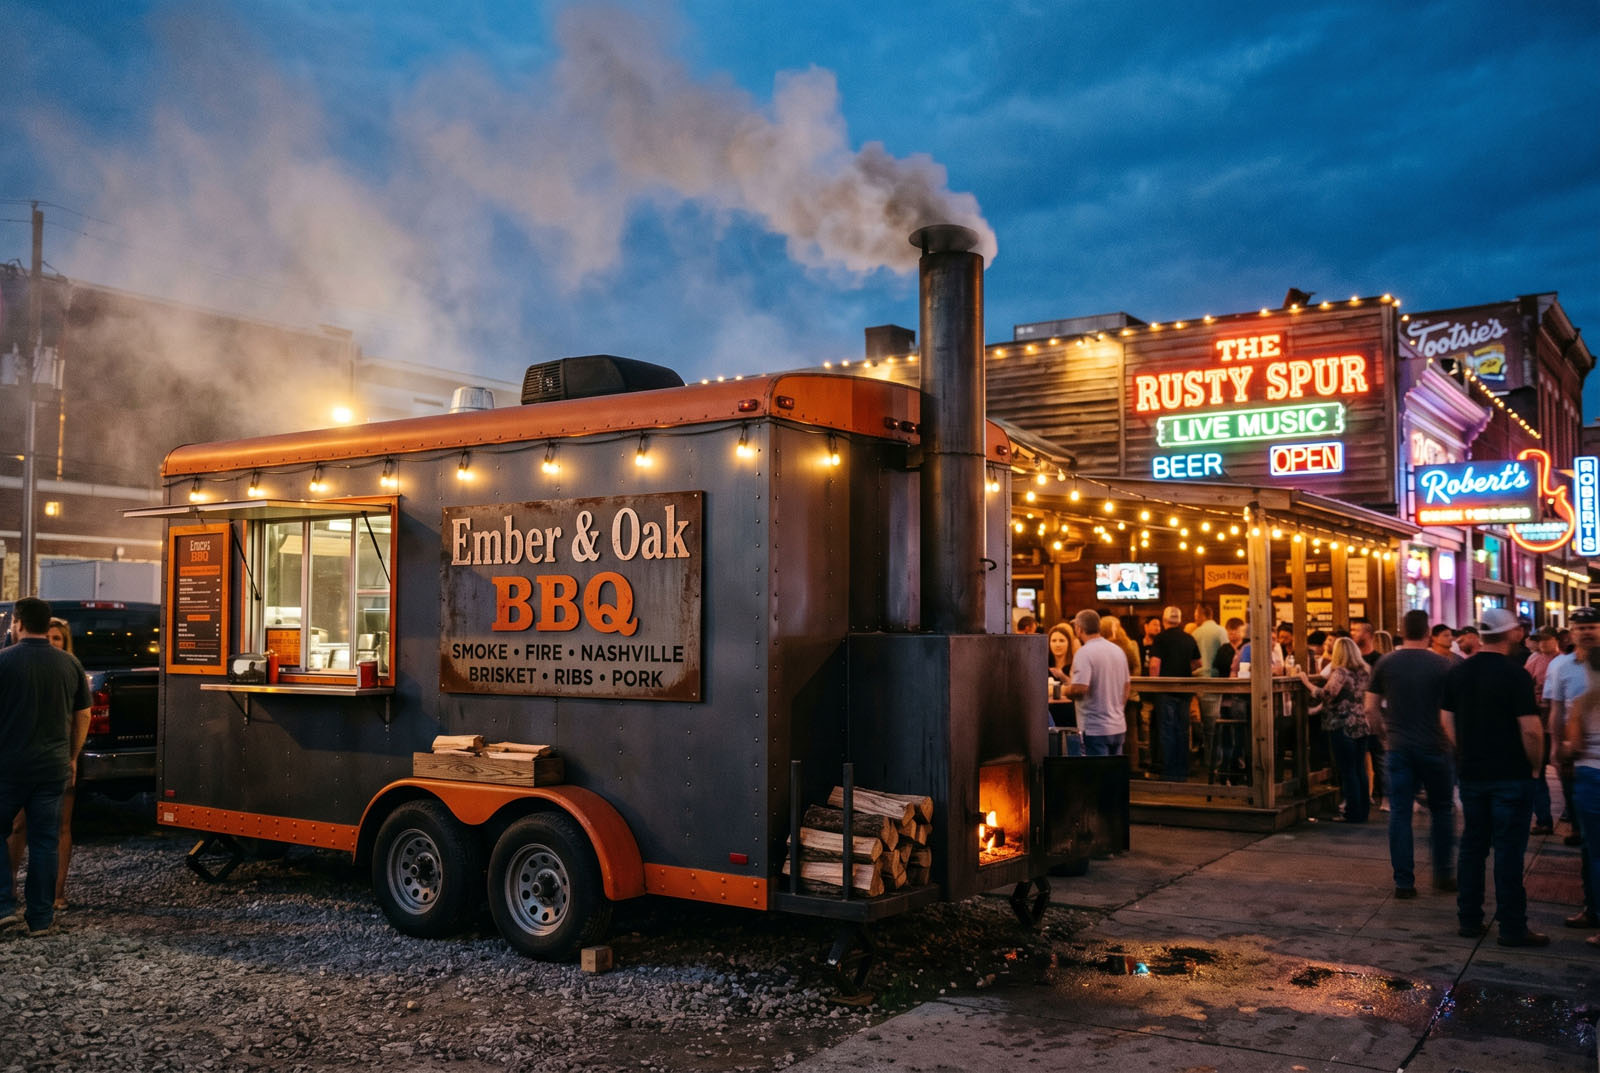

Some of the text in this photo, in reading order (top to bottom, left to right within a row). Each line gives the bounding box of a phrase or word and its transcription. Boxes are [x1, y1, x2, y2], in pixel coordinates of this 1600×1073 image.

[1216, 334, 1281, 361] THE
[1407, 318, 1508, 357] Tootsie's
[1136, 355, 1369, 411] RUSTY SPUR
[1173, 408, 1327, 442] LIVE MUSIC
[1152, 453, 1223, 479] BEER
[1273, 445, 1339, 473] OPEN
[1421, 462, 1530, 504] Robert's
[1580, 460, 1596, 552] ROBERTS
[451, 504, 691, 566] Ember & Oak
[491, 571, 638, 637] BBQ
[452, 643, 684, 663] SMOKE FIRE NASHVILLE
[469, 666, 664, 688] BRISKET RIBS PORK
